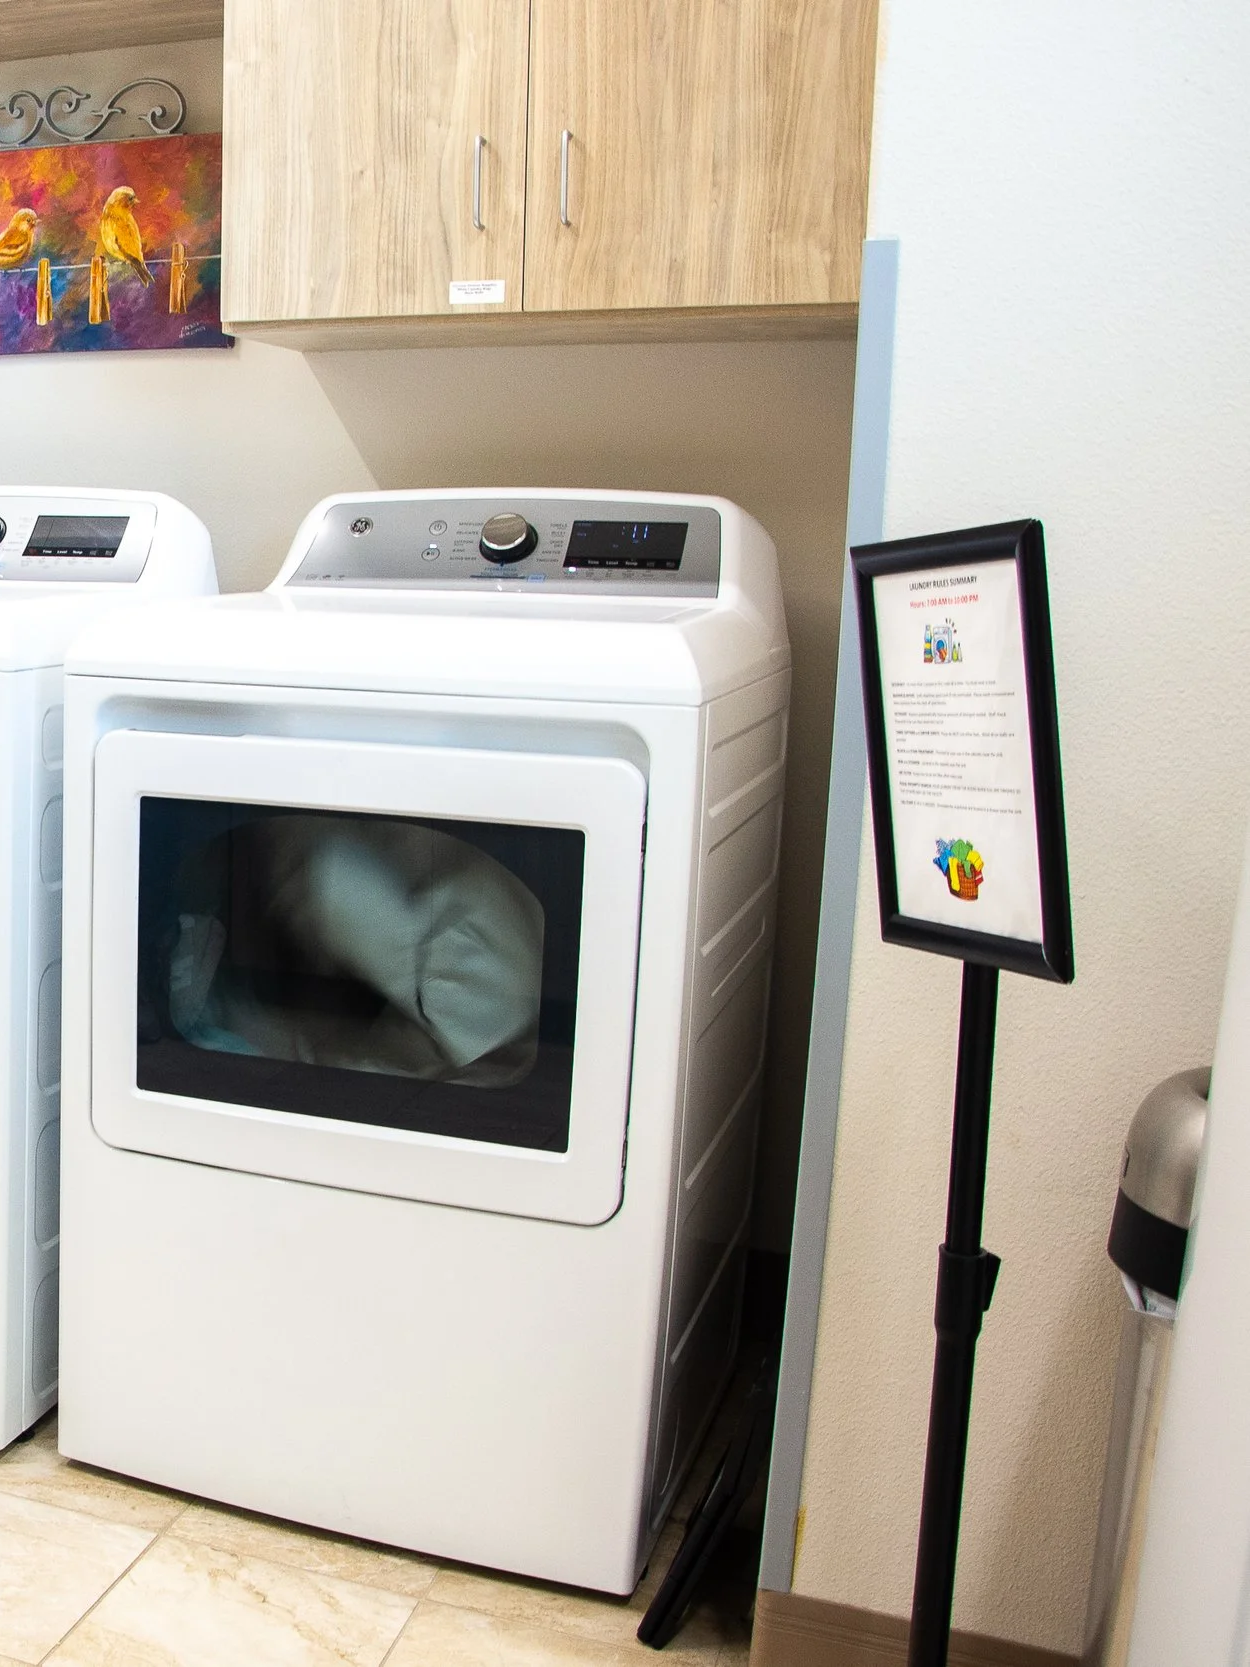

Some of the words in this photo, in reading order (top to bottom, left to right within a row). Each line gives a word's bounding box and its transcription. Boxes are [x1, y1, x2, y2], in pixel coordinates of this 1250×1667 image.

[909, 581, 932, 591] LAUNDRY
[932, 578, 949, 589] RULES
[949, 576, 977, 587] SUMMARY
[938, 597, 947, 606] AM
[968, 594, 978, 603] PM
